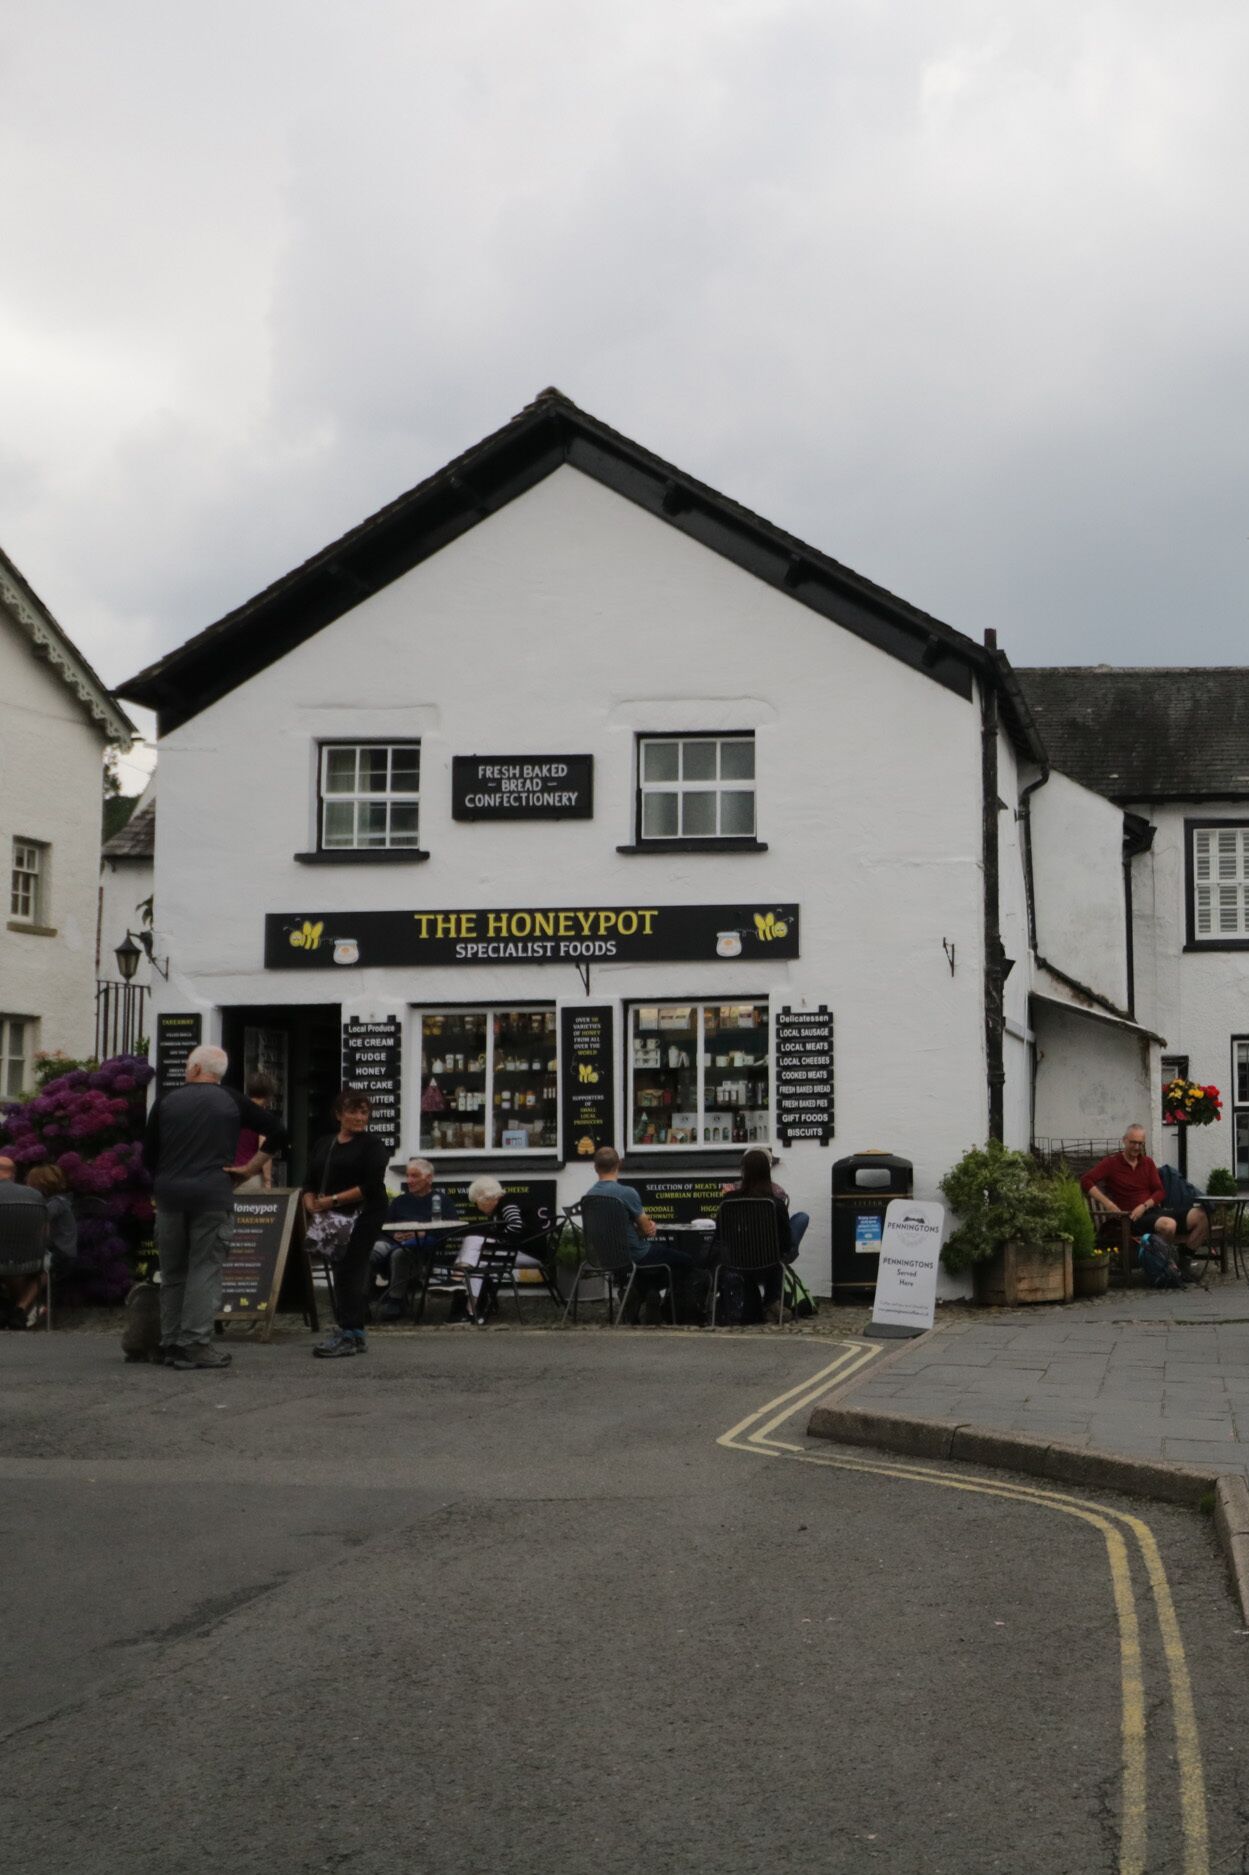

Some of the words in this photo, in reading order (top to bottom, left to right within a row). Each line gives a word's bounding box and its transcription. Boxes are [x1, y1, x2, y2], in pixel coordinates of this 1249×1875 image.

[478, 765, 520, 779] FRESH
[523, 764, 568, 778] BAKED
[501, 778, 542, 792] BREAD
[465, 792, 578, 807] CONFECTIONERY
[414, 913, 477, 938] THE
[487, 910, 659, 937] HONEYPOT
[456, 942, 554, 958] SPECIALIST
[559, 941, 617, 956] FOODS
[780, 1015, 829, 1023] Delicatessen
[348, 1025, 366, 1033] Local
[780, 1029, 800, 1037] LOCAL
[800, 1028, 829, 1036] SAUSAGE
[349, 1039, 362, 1047] ICE
[364, 1038, 394, 1046] CREAM
[781, 1043, 804, 1051] LOCAL
[805, 1042, 829, 1050] MEATS
[355, 1053, 387, 1061] FUDGE
[780, 1057, 800, 1066] LOCAL
[801, 1056, 830, 1065] CHEESES
[355, 1067, 386, 1075] HONEY
[781, 1071, 807, 1079] COOKED
[808, 1070, 828, 1078] MEATS
[370, 1081, 393, 1089] CAKE
[780, 1086, 796, 1094] FRESH
[796, 1085, 813, 1093] BAKED
[814, 1084, 830, 1092] BREAD
[368, 1095, 394, 1104] UTTER
[782, 1100, 798, 1108] FRESH
[799, 1100, 816, 1108] BAKED
[816, 1099, 828, 1107] PIES
[782, 1114, 799, 1122] GIFT
[801, 1114, 828, 1122] FOODS
[369, 1124, 395, 1132] CHEESE
[787, 1128, 823, 1136] BISCUITS
[888, 1222, 940, 1233] PENNINGTONS
[883, 1257, 934, 1269] PENNINGTONS
[897, 1269, 918, 1278] Served
